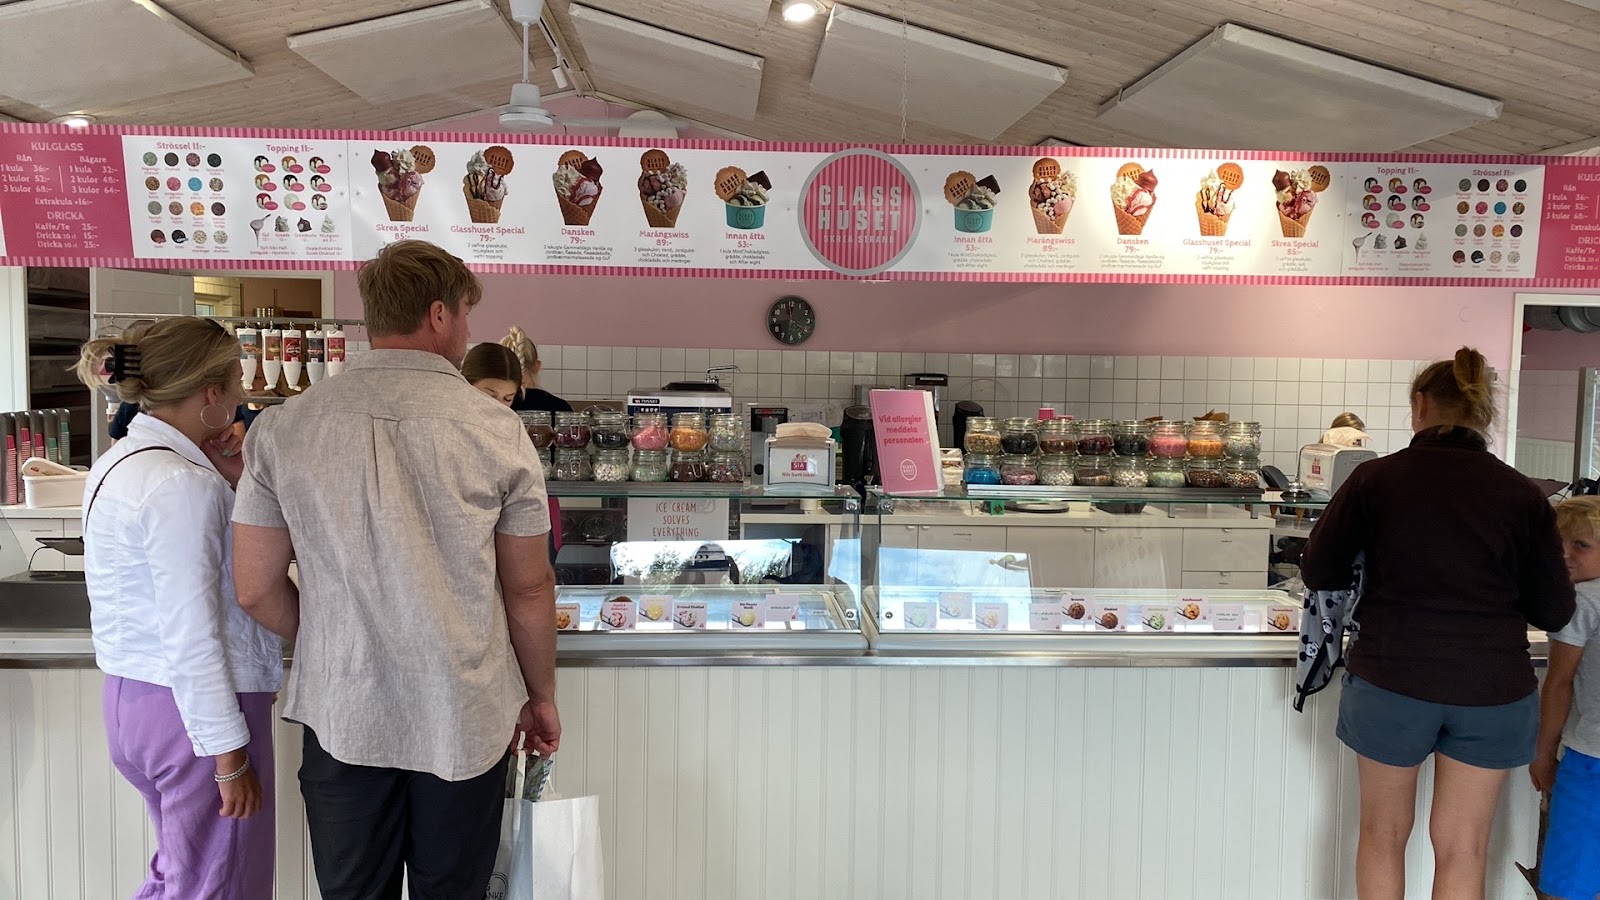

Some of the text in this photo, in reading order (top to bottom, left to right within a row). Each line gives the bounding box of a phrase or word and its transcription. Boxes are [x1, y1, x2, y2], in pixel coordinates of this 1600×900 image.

[31, 142, 84, 152] KULGLASS
[266, 144, 299, 153] Topping
[16, 154, 32, 162] Rån
[6, 164, 24, 172] kula
[1377, 167, 1406, 176] Topping
[8, 174, 30, 182] kulor
[818, 185, 902, 207] GLASS
[47, 212, 84, 220] DRICKA
[818, 210, 900, 231] HUSET
[401, 225, 429, 233] Special
[450, 226, 525, 235] Glasshuset Special
[640, 230, 689, 239] Marängswiss
[858, 235, 894, 243] STRAND
[1027, 236, 1075, 245] Marängswiss
[1183, 238, 1251, 248] Glasshuset Special
[1293, 240, 1319, 249] Special
[892, 415, 922, 424] allergier
[883, 437, 924, 446] personalen
[656, 503, 697, 512] ICE CREAM
[663, 515, 690, 525] SOLVES
[653, 528, 698, 537] EVERYTHING
